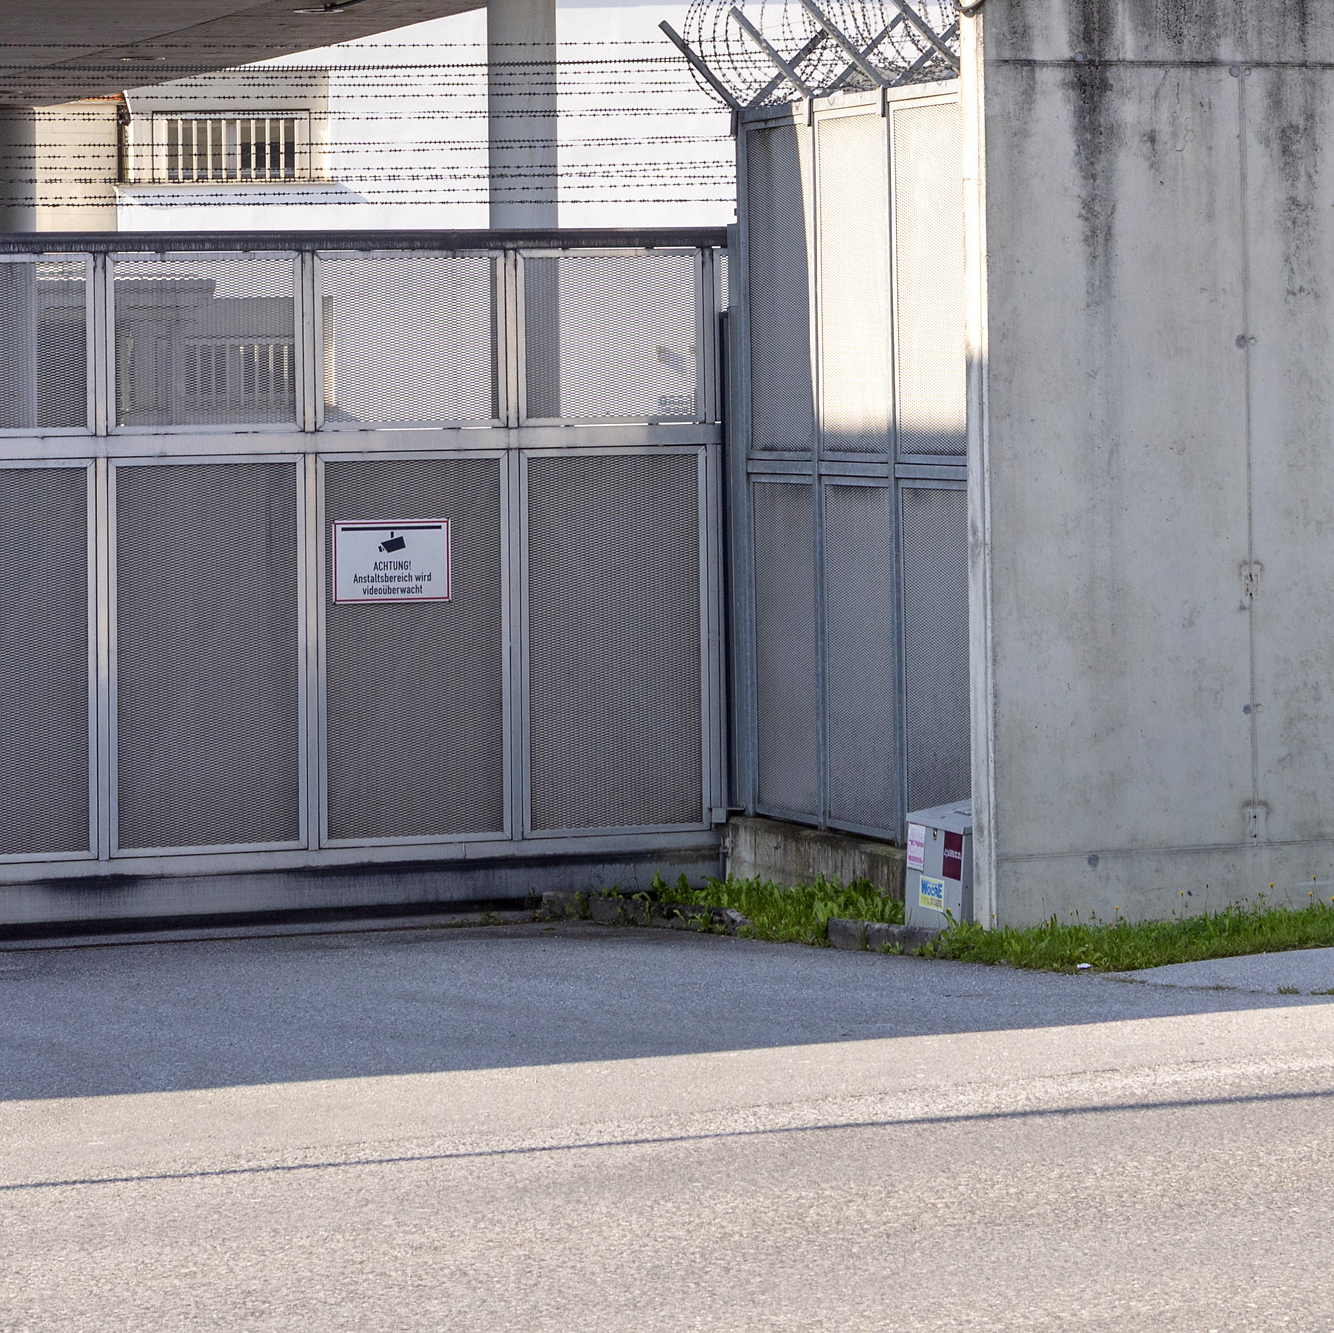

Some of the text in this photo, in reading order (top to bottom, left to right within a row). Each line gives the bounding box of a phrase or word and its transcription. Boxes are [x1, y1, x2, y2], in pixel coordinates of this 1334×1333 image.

[373, 560, 412, 572] ACHTUNG!
[353, 571, 432, 584] Anstaltsbereich wird
[362, 584, 423, 596] videoüberwacht
